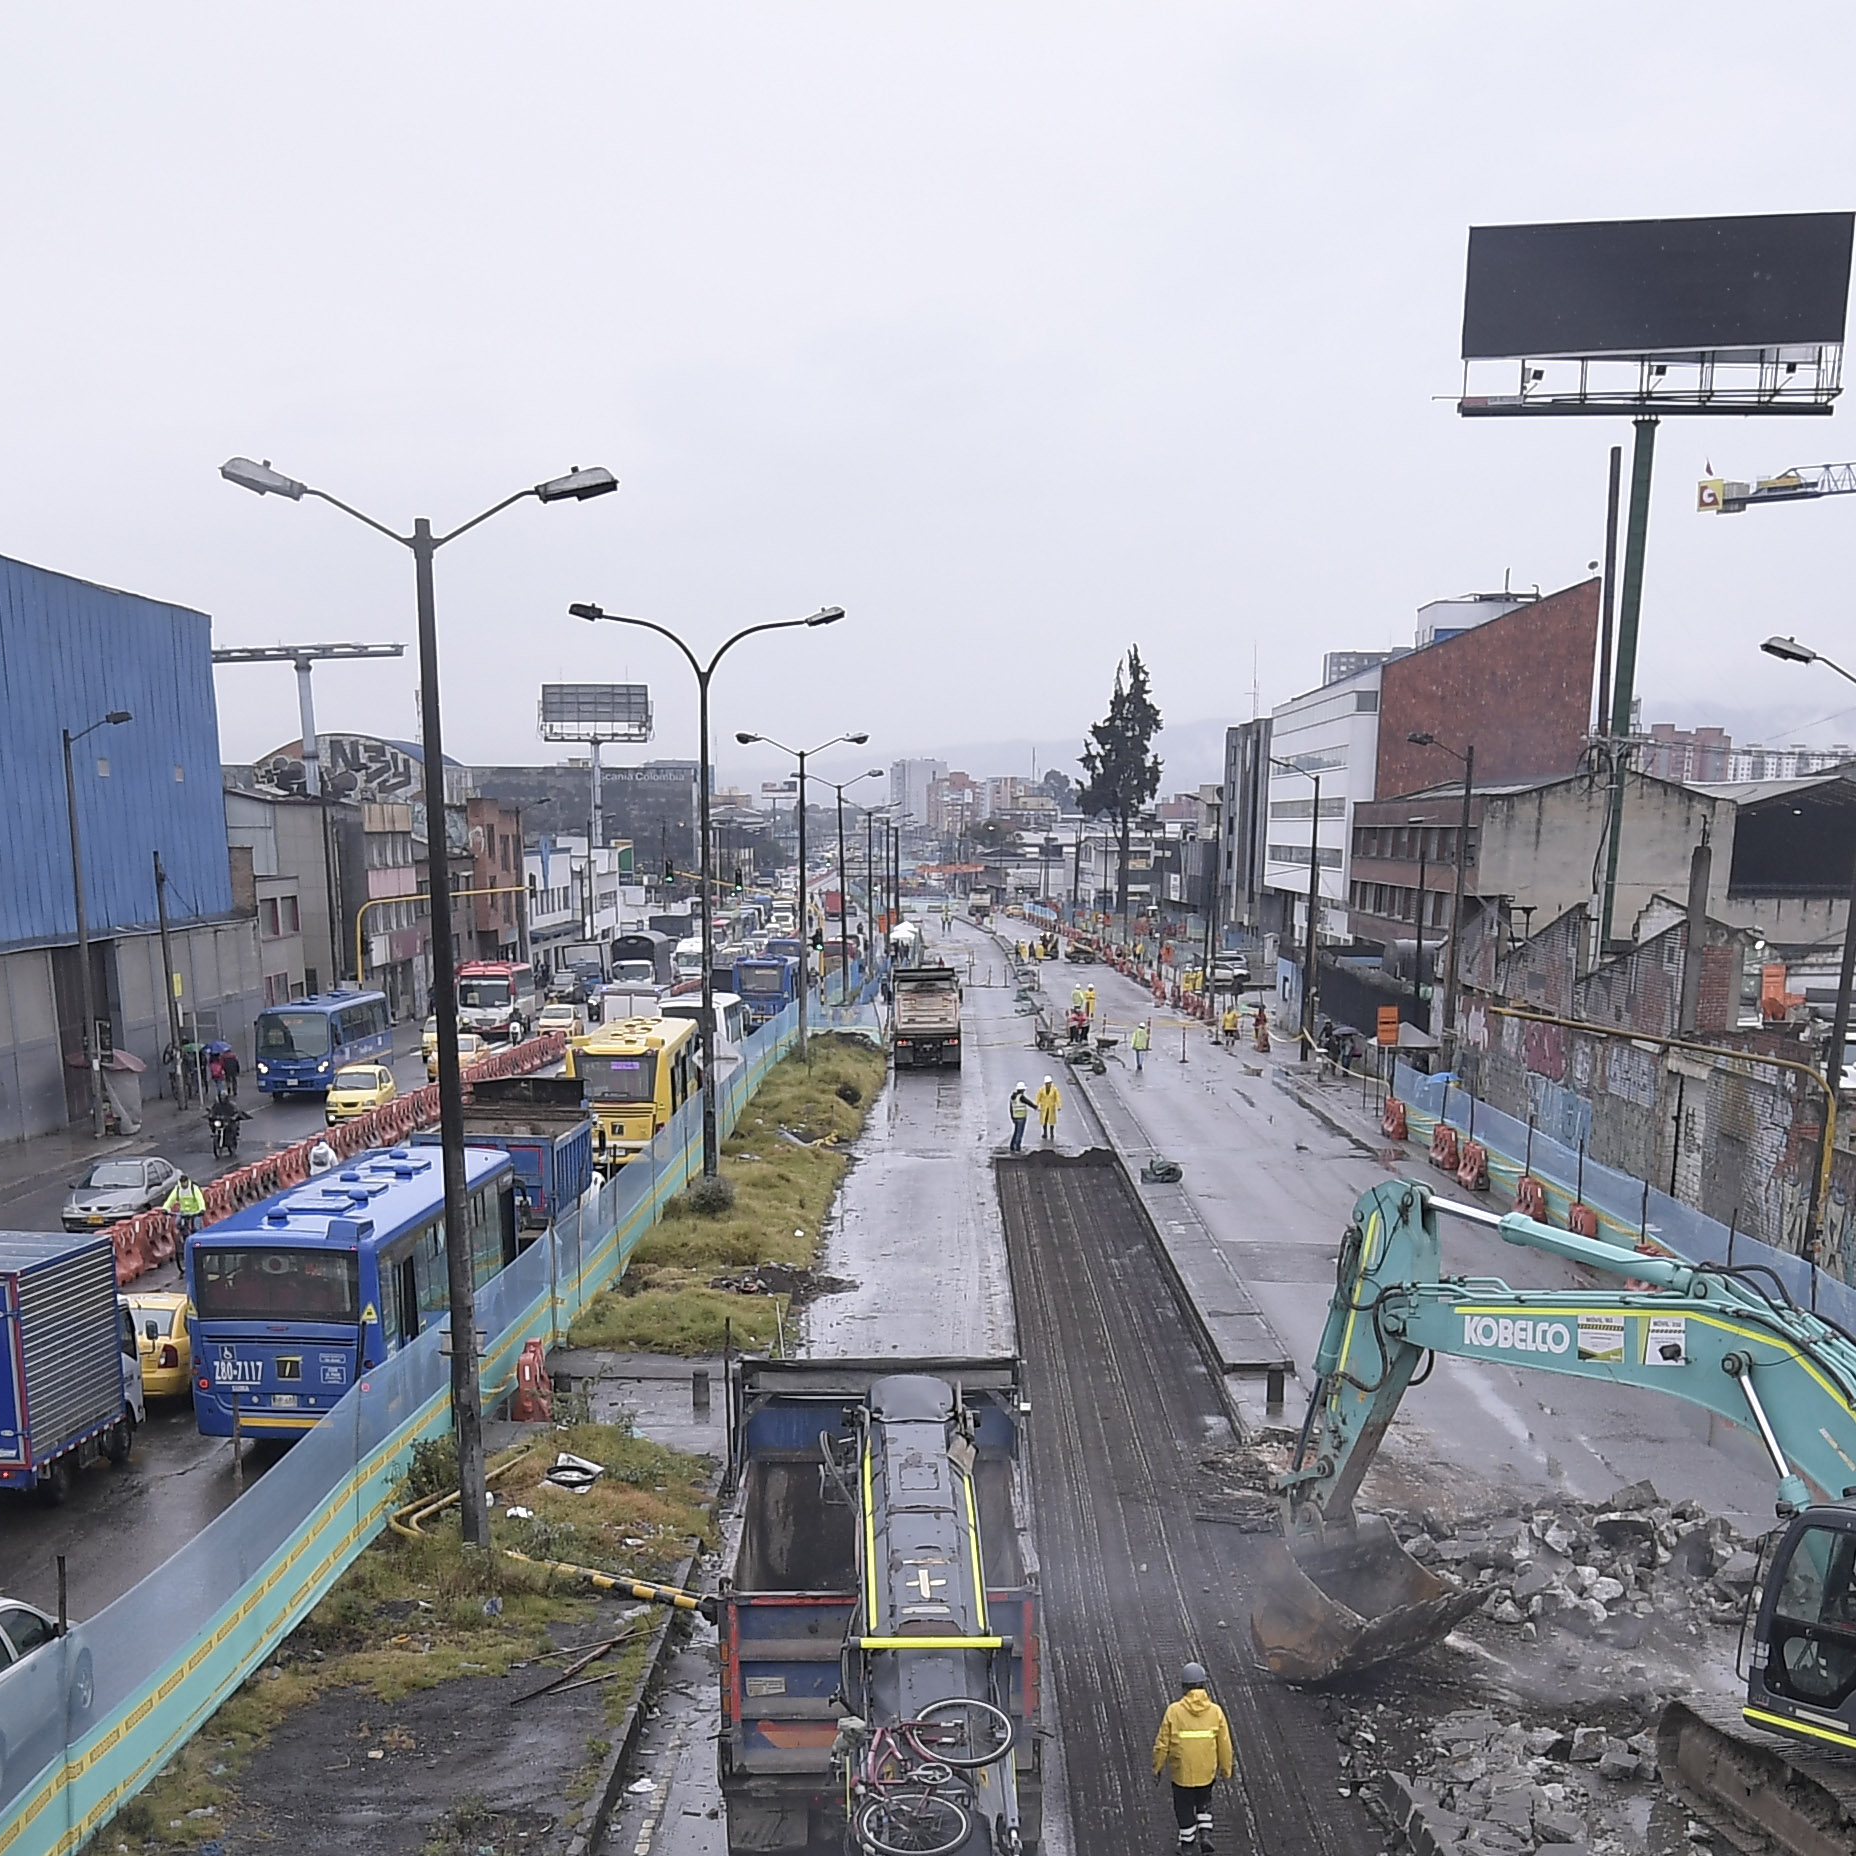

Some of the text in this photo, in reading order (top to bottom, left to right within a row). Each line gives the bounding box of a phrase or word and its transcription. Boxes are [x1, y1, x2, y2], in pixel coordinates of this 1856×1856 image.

[635, 772, 685, 781] Colombia
[1464, 1315, 1571, 1354] KOBELCO
[214, 1361, 263, 1381] Z80-7117
